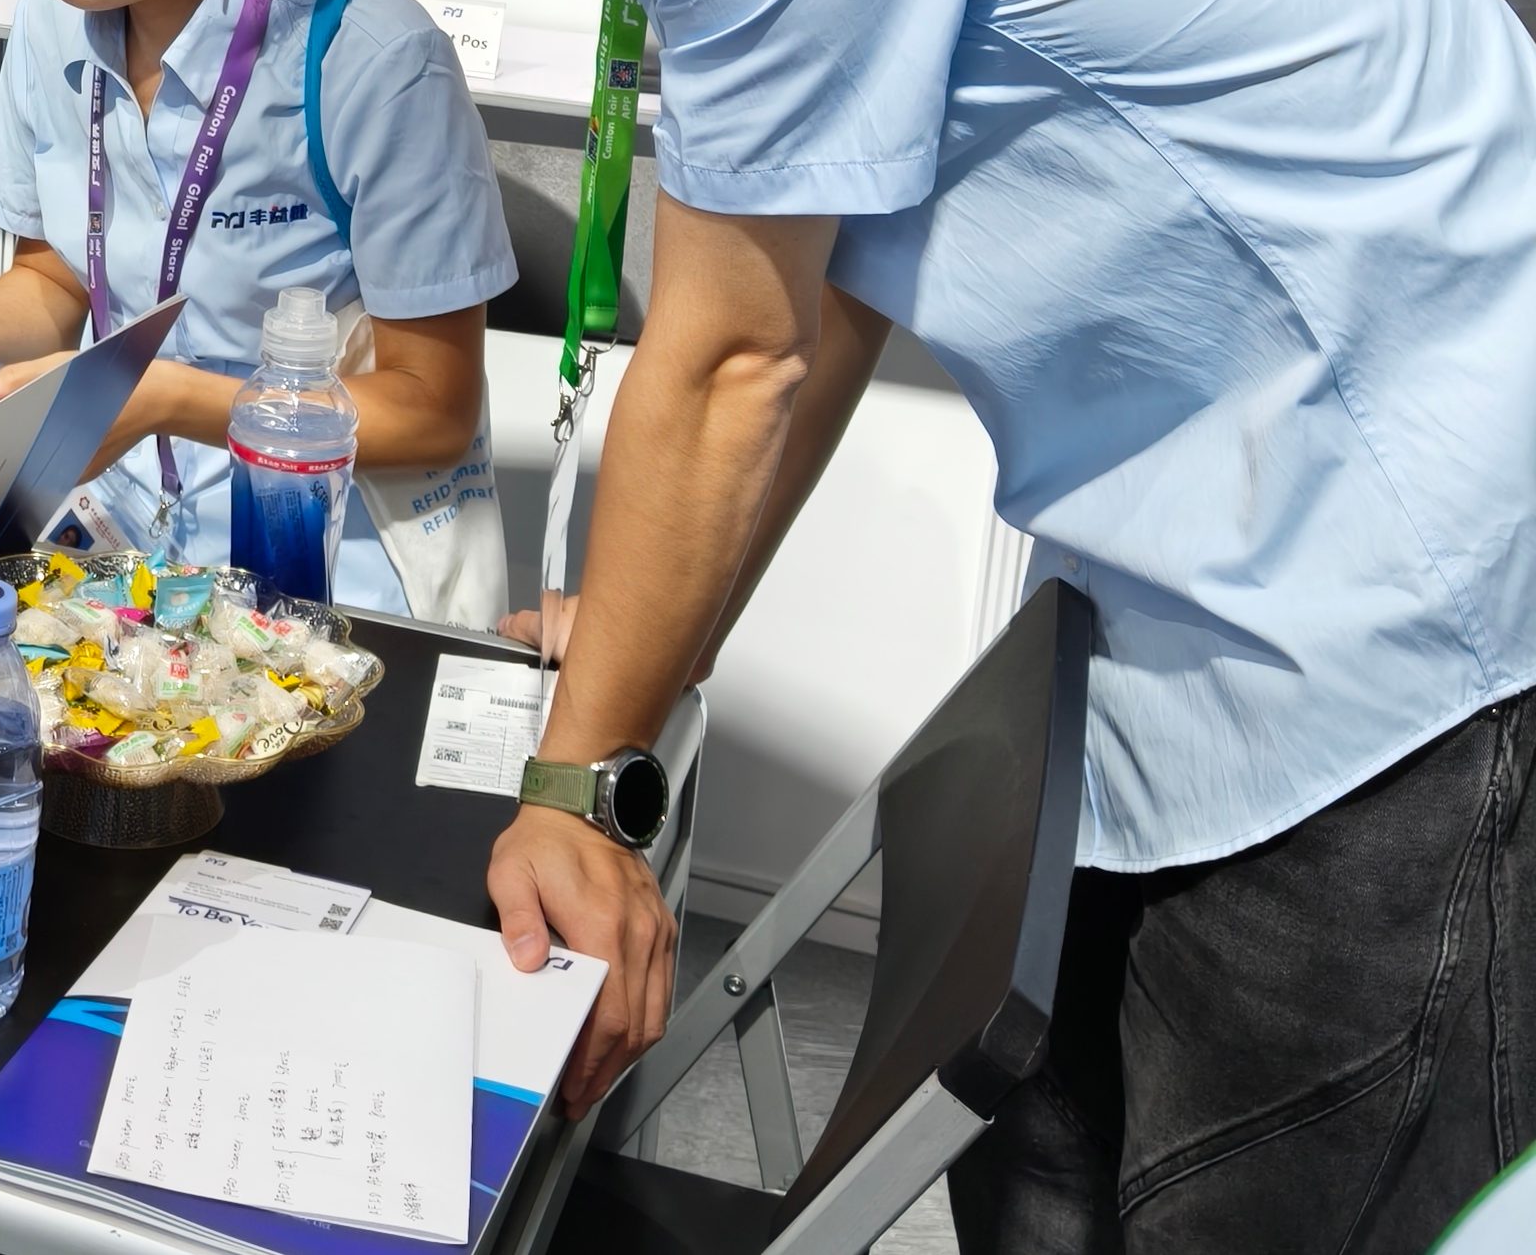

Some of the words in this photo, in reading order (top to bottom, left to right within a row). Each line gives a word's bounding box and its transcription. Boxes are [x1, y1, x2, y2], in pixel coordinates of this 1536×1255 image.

[461, 34, 488, 50] Pos
[596, 35, 609, 91] Share
[206, 85, 237, 138] Canton
[606, 93, 618, 116] Fair
[620, 96, 632, 120] APP
[602, 122, 615, 159] Canton
[194, 144, 214, 176] Fair
[175, 182, 202, 231] Global
[166, 238, 184, 283] Share
[412, 484, 452, 513] RFID
[422, 504, 459, 536] RFID
[177, 903, 199, 916] To
[204, 909, 233, 924] Be
